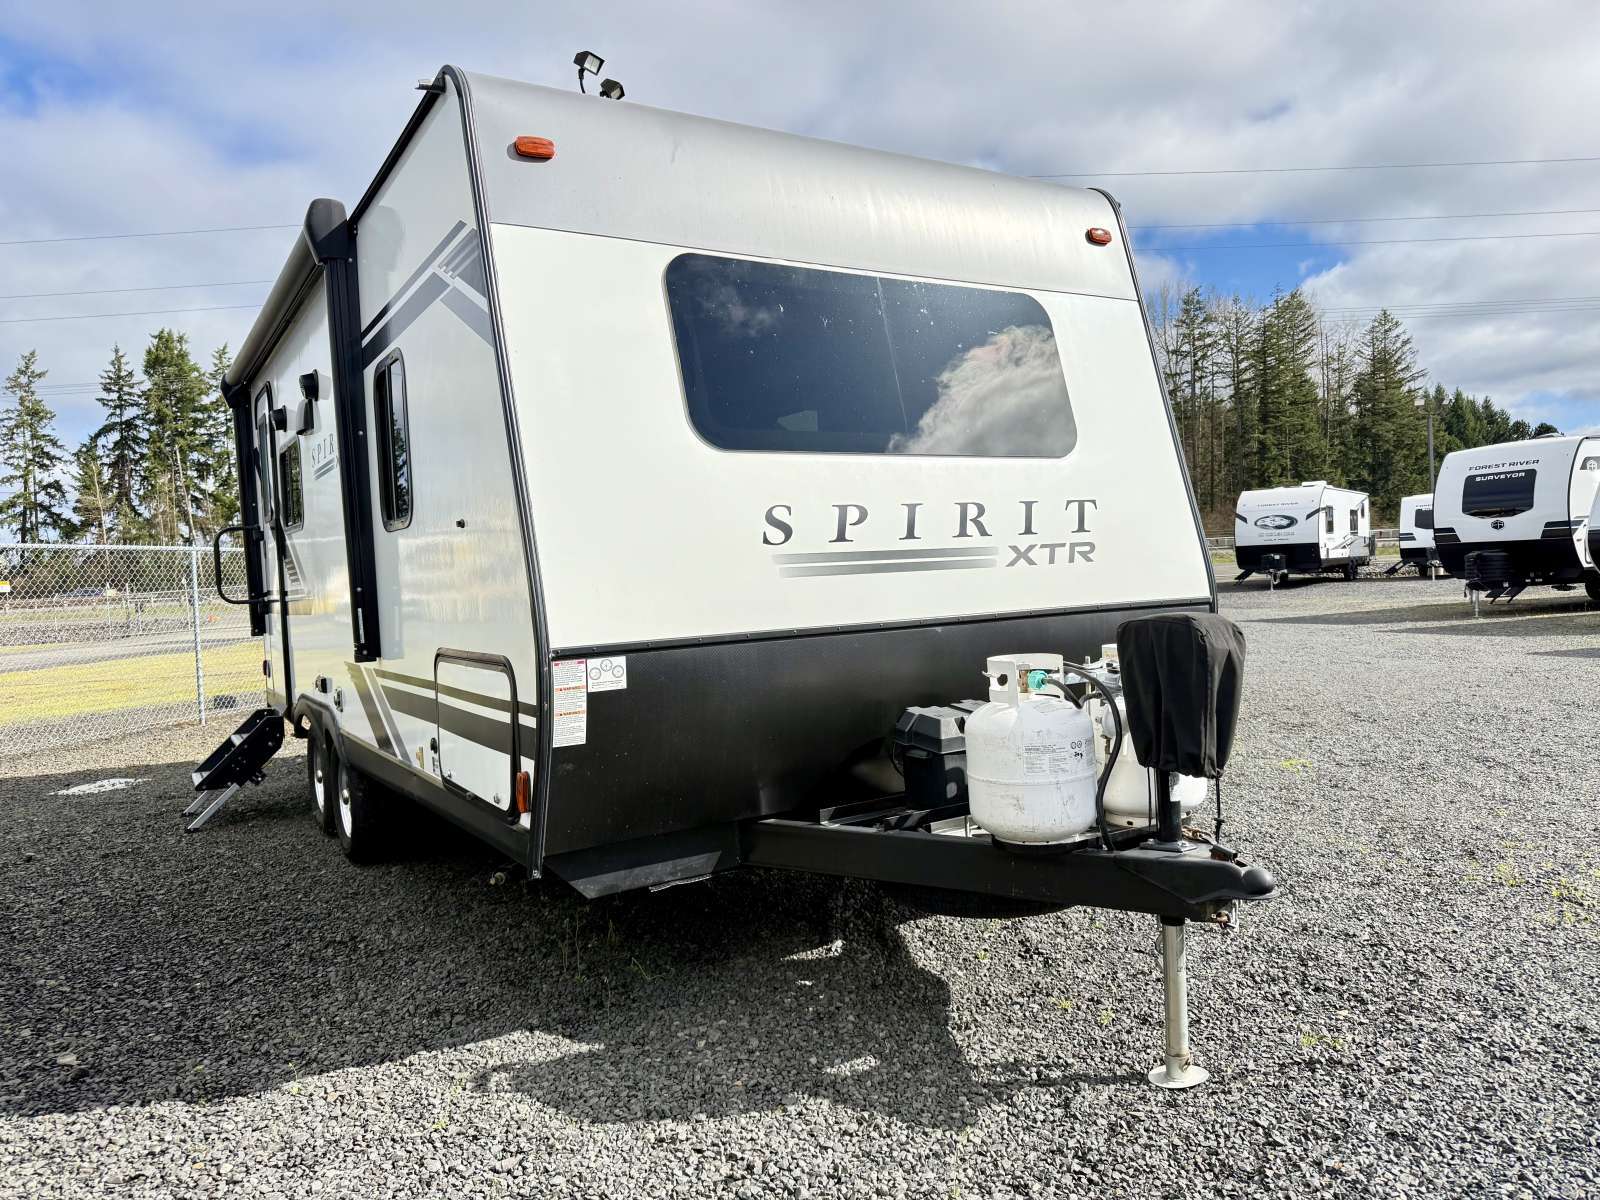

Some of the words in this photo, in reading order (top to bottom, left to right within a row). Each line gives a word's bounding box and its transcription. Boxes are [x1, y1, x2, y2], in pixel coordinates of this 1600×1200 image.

[312, 433, 334, 468] SPIR
[1468, 462, 1507, 471] FOREST
[1508, 459, 1540, 467] RIVER
[1475, 472, 1525, 482] SURVEYOR
[763, 499, 1098, 546] SPIRIT
[1005, 541, 1096, 567] XTR
